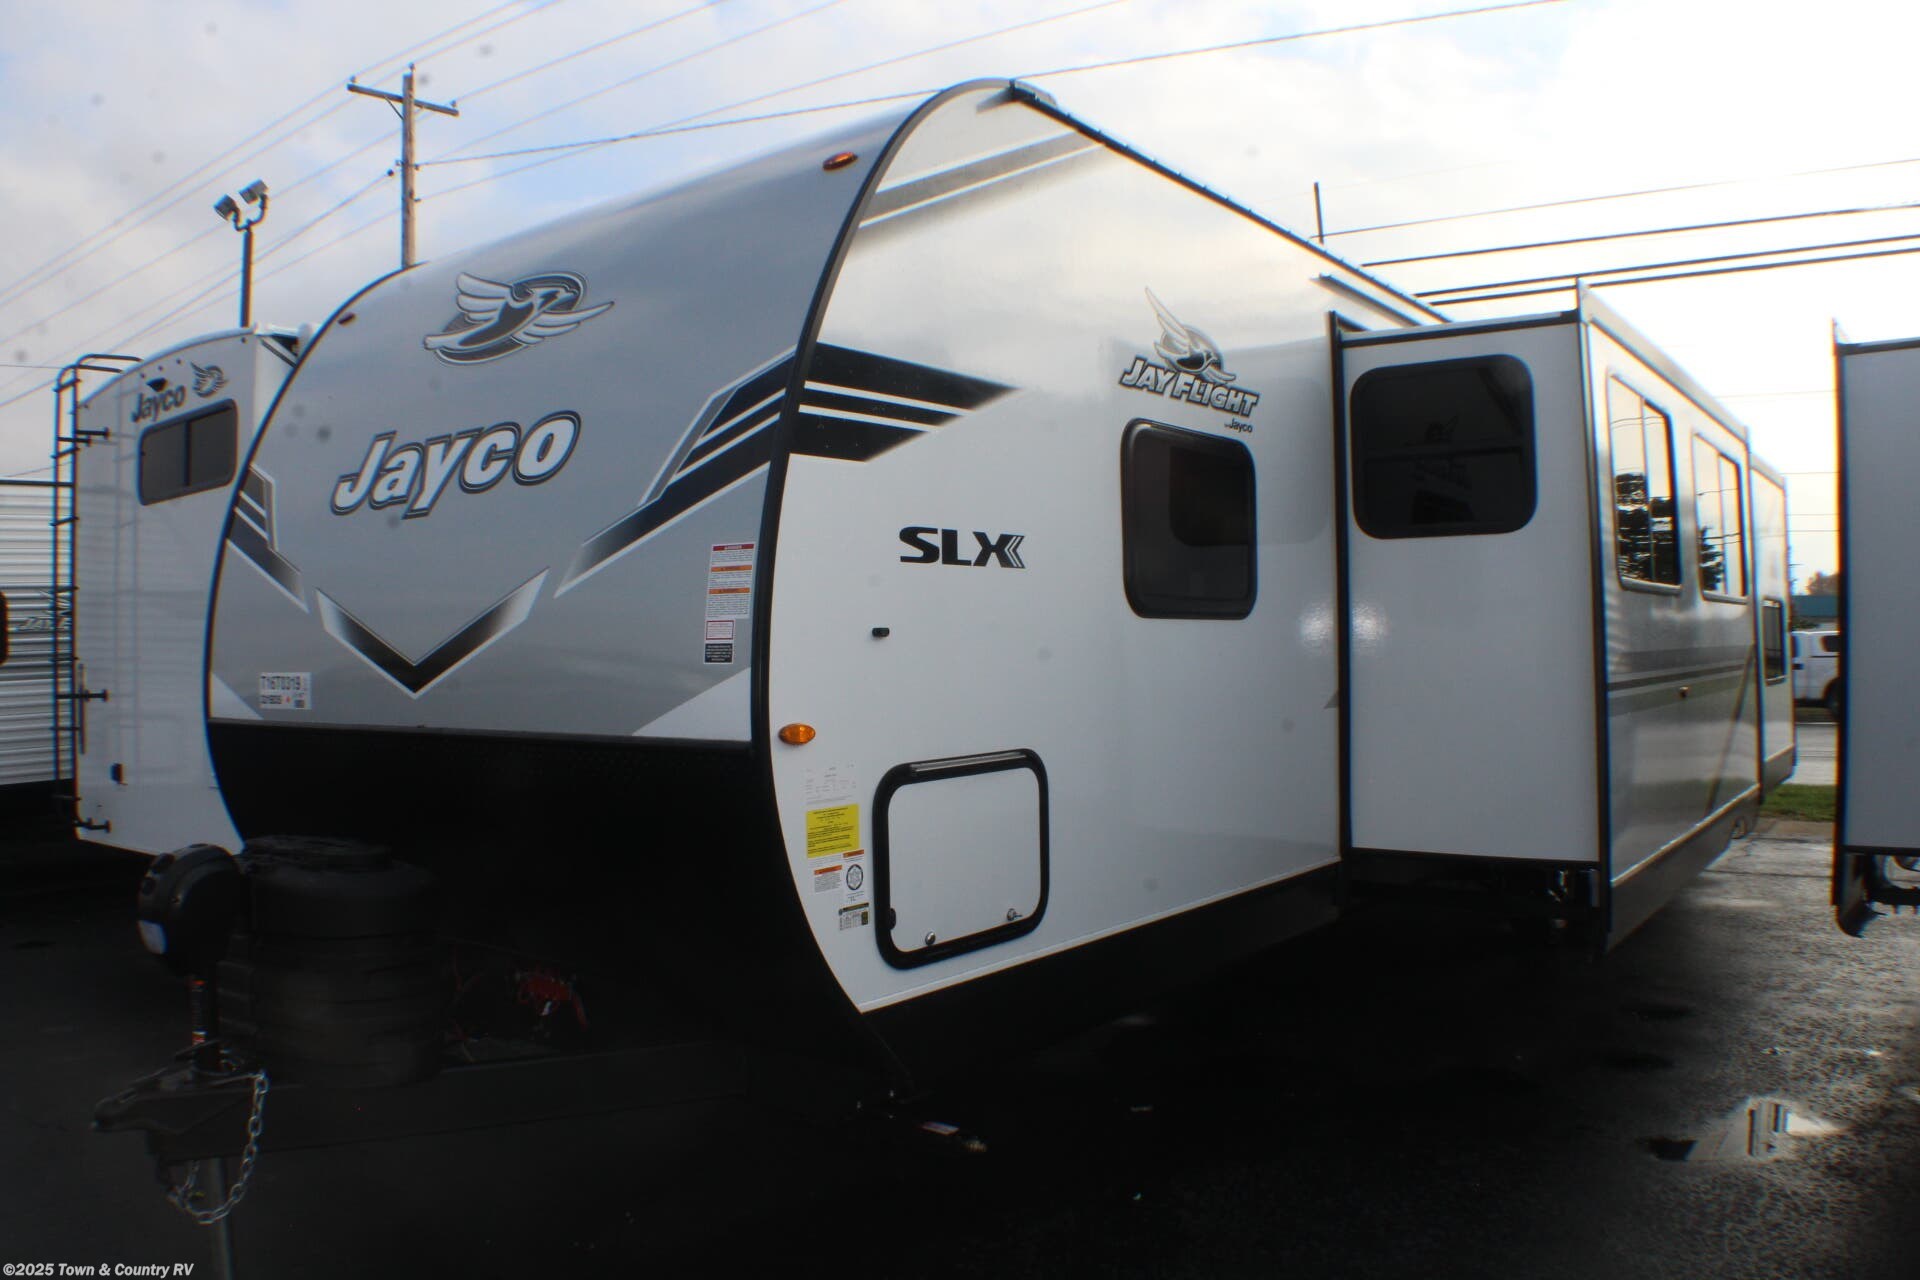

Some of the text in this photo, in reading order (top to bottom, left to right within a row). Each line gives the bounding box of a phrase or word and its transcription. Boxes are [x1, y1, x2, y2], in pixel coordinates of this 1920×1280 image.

[131, 385, 187, 422] Jayco
[1119, 355, 1260, 417] JAY FLIGHT
[1231, 418, 1253, 434] Jayco
[331, 410, 582, 520] Jayco
[899, 526, 1025, 569] SLX
